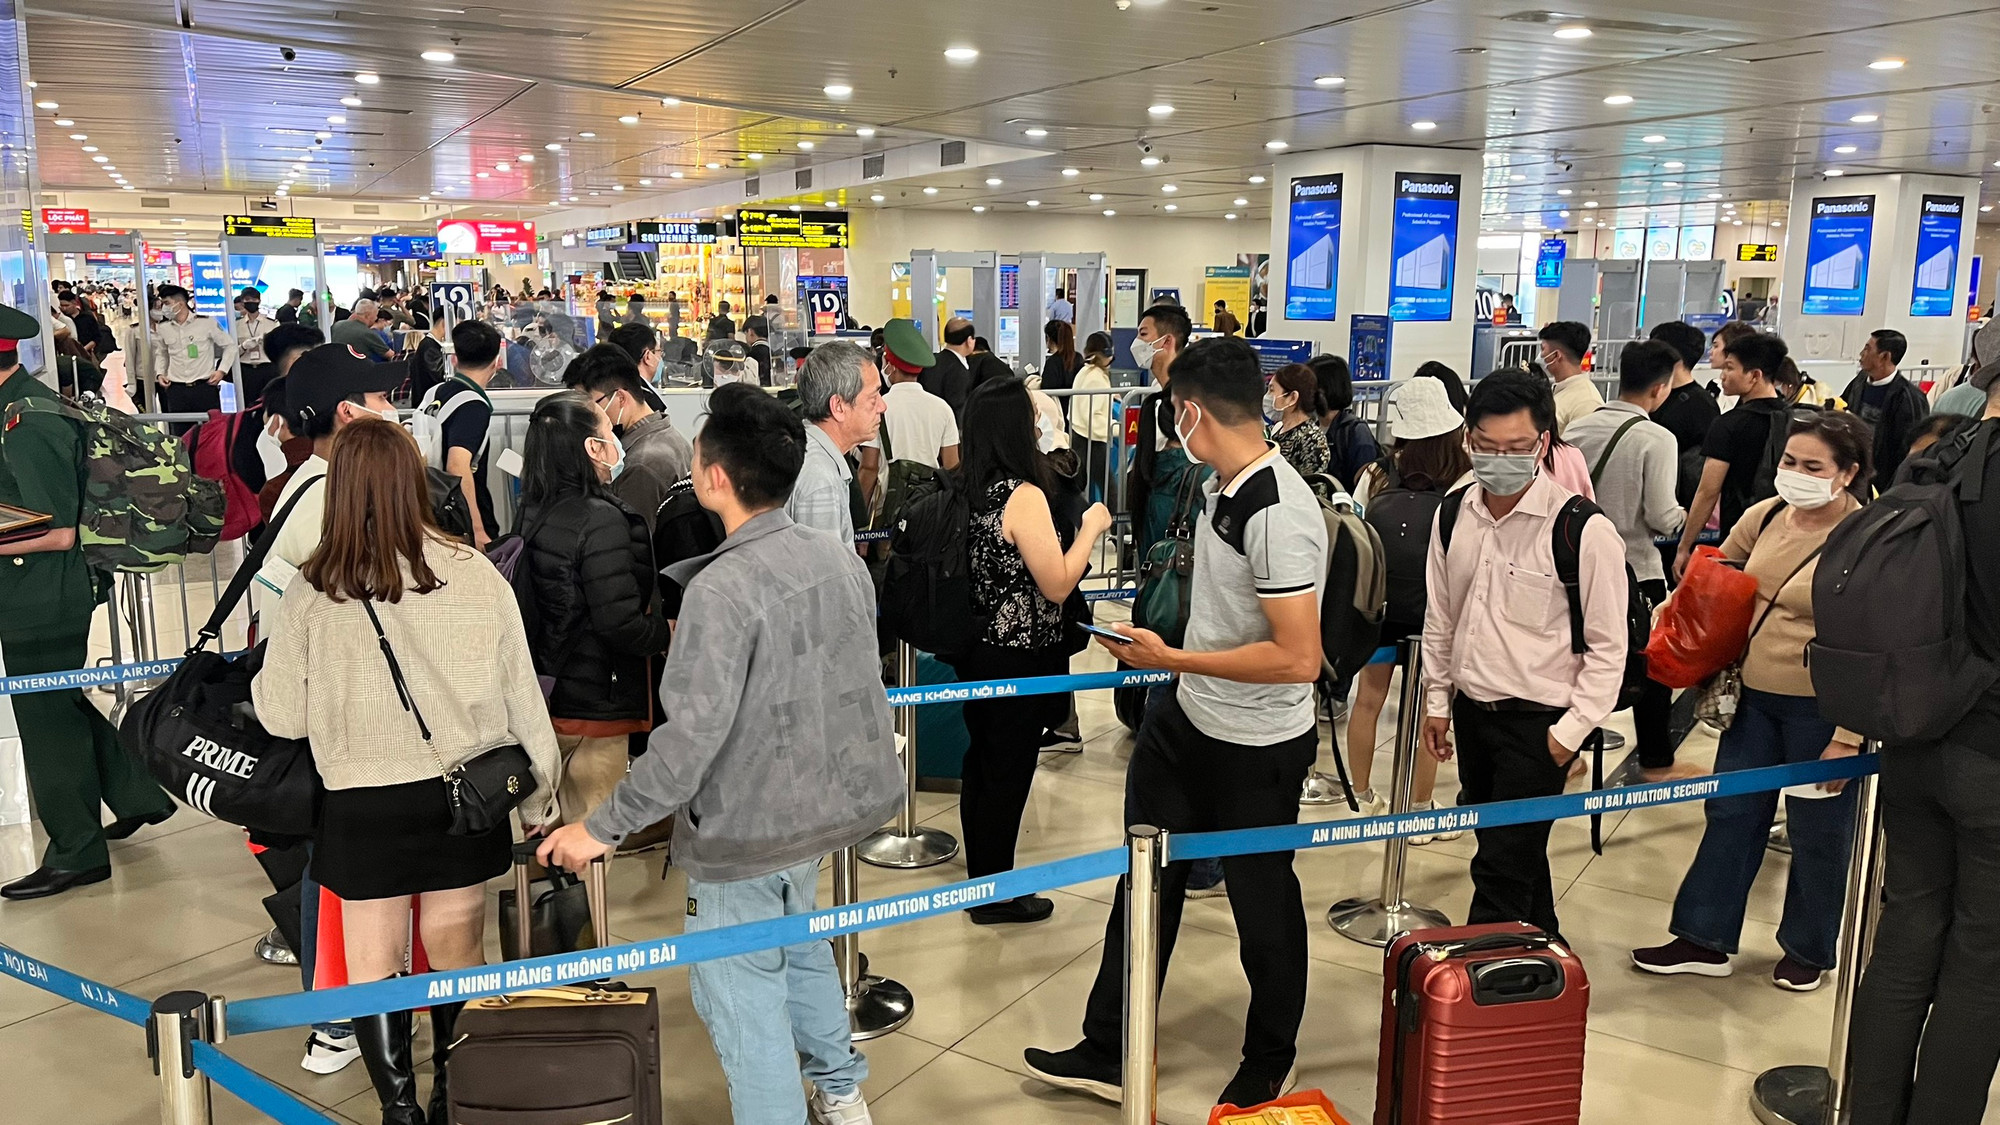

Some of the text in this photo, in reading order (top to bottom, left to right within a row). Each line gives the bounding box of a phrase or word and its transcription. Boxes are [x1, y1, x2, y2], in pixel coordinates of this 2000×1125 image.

[1295, 181, 1338, 197] Panasonic
[1401, 179, 1454, 195] Panasonic
[1817, 201, 1869, 214] Panasonic
[1925, 201, 1960, 214] Panasonic
[658, 223, 698, 234] LOTUS
[641, 233, 715, 243] SOUVENIR SHOP
[434, 286, 473, 321] 13
[811, 293, 843, 326] 12
[1475, 291, 1493, 320] 10
[1084, 590, 1131, 600] SECURITY
[8, 668, 118, 690] INTERNATIONAL
[122, 662, 179, 679] AIRPORT
[1122, 672, 1171, 685] AN NINH
[924, 688, 969, 701] KHÔNG
[972, 684, 993, 698] NỘI
[1584, 779, 1720, 811] NOI BAI AVIATION SECURITY
[1311, 810, 1479, 843] AN NINH HÀNG KHÔNG NỘI BÀI
[809, 881, 996, 934] NOI BAI AVIATION SECURITY
[427, 944, 676, 999] AN NINH HÀNG KHÔNG NỘI BÀI
